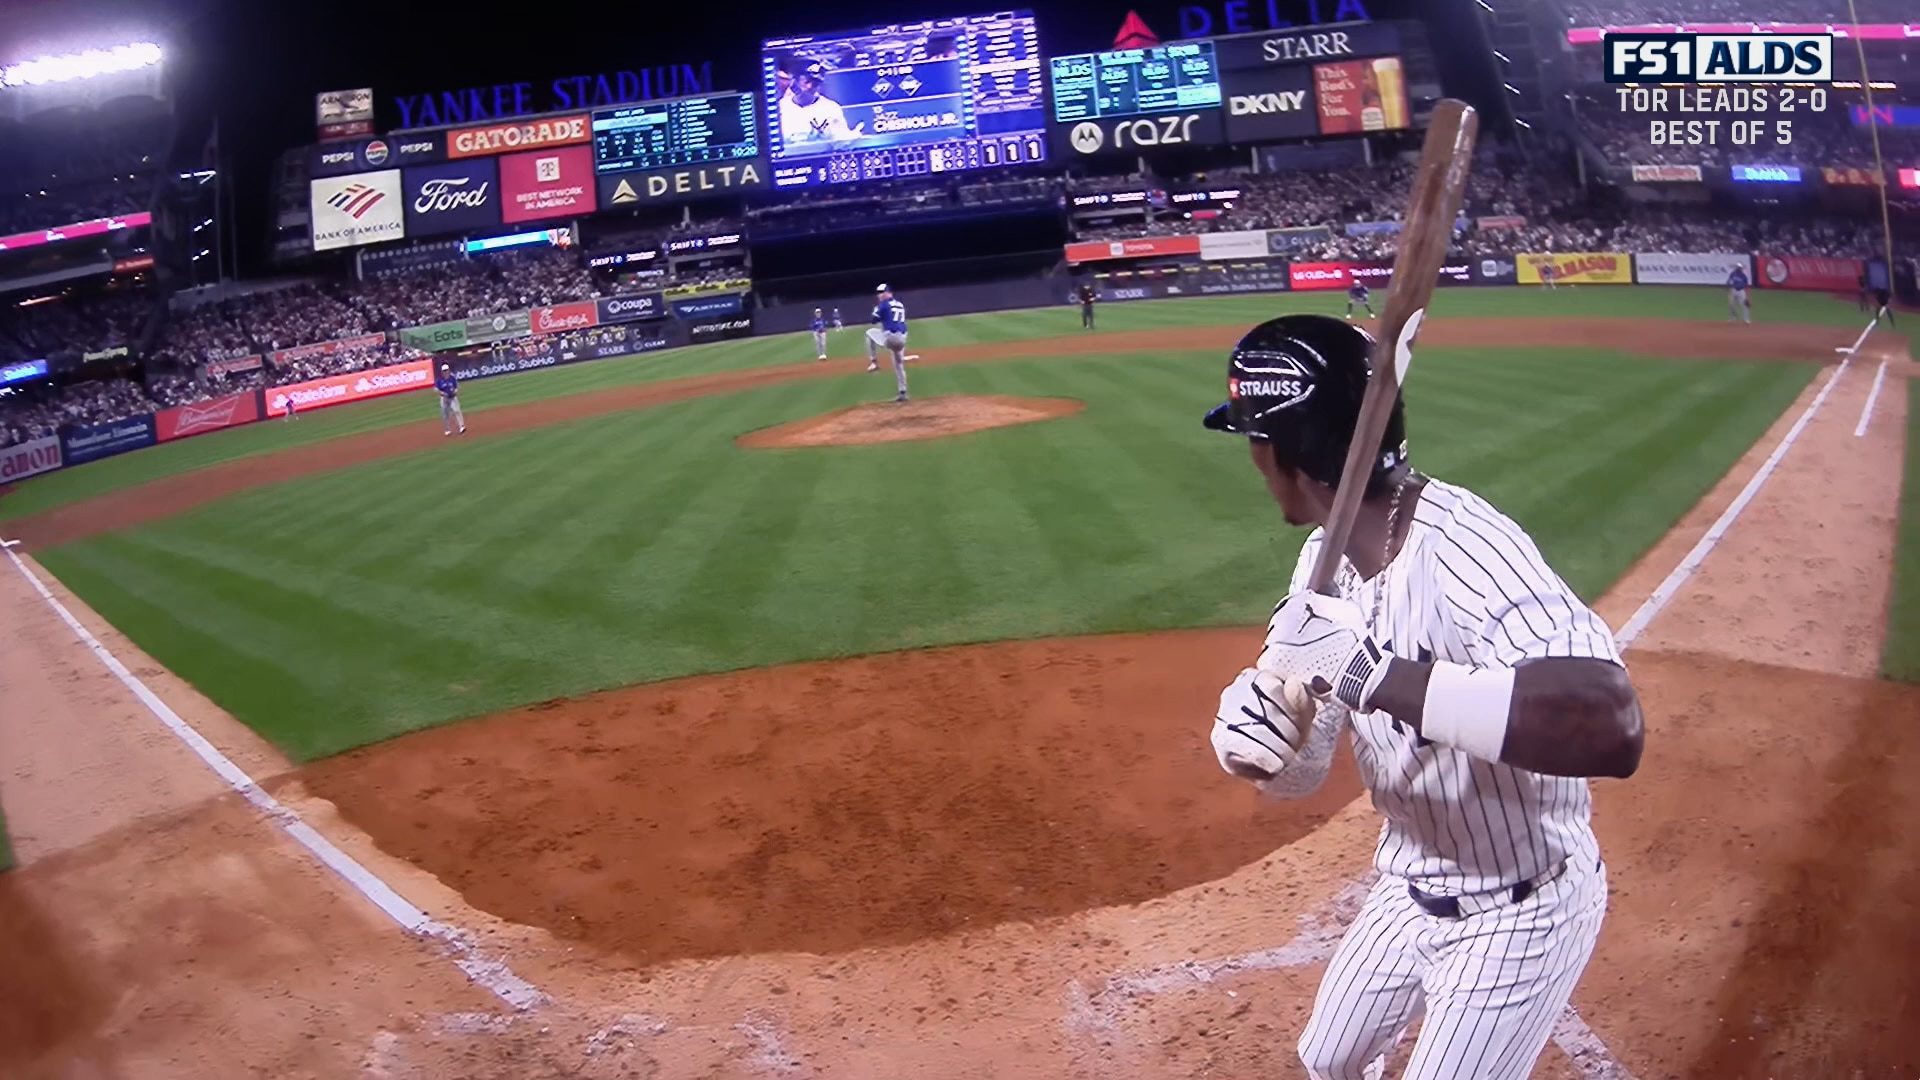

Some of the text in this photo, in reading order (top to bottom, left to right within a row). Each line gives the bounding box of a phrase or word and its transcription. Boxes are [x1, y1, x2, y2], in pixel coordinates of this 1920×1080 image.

[1262, 31, 1353, 61] STARR
[1316, 65, 1348, 79] This
[395, 61, 713, 129] YANKEE STADIUM
[1229, 91, 1305, 116] DKNY
[456, 119, 585, 152] GATORADE
[1113, 114, 1200, 148] razr
[322, 152, 354, 164] PEPSI
[400, 142, 433, 154] PEPSI
[986, 141, 1039, 163] 1 1 1
[648, 165, 760, 197] DELTA
[414, 177, 489, 214] Ford
[536, 196, 576, 208] AMERICA
[538, 186, 583, 199] NETWORK
[315, 222, 401, 241] BANK OF AMERICA
[621, 298, 652, 310] coupa
[434, 331, 463, 343] Eats
[1239, 380, 1301, 397] STRAUSS
[1, 446, 60, 478] anon
